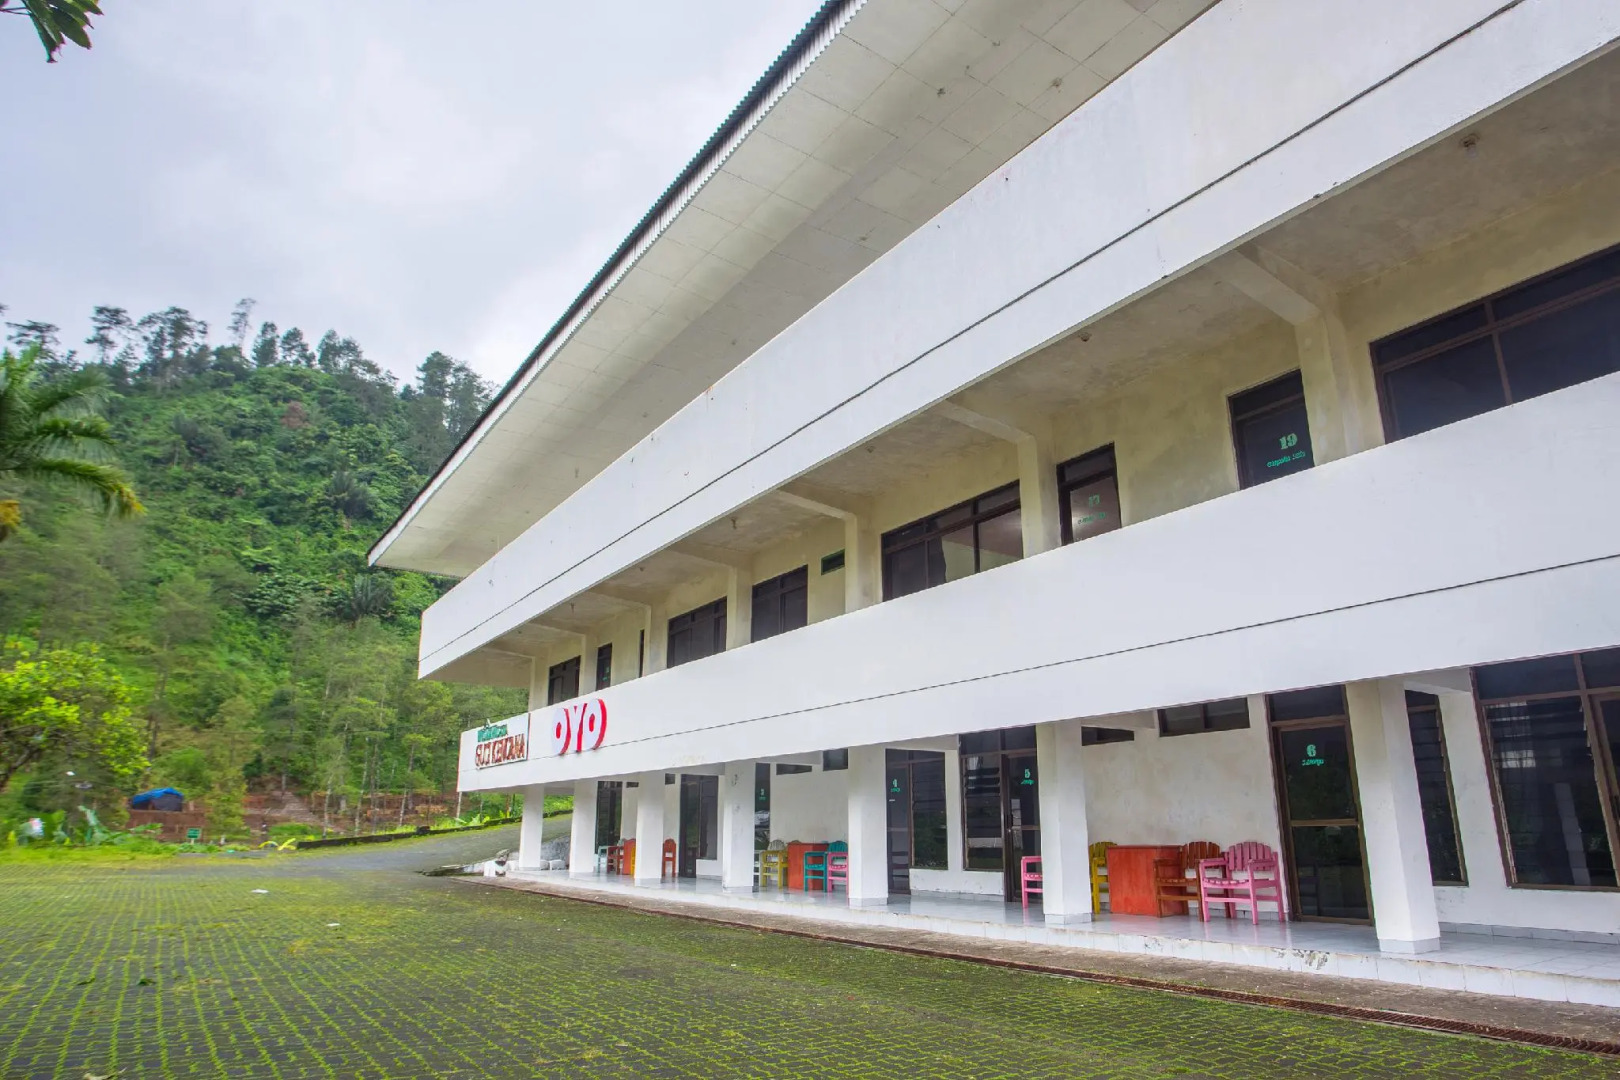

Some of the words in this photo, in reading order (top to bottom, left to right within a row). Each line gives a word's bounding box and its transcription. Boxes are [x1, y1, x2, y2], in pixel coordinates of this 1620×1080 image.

[1280, 433, 1297, 449] 19
[552, 698, 607, 755] OYO
[1307, 744, 1316, 757] 6
[1024, 768, 1031, 778] 5
